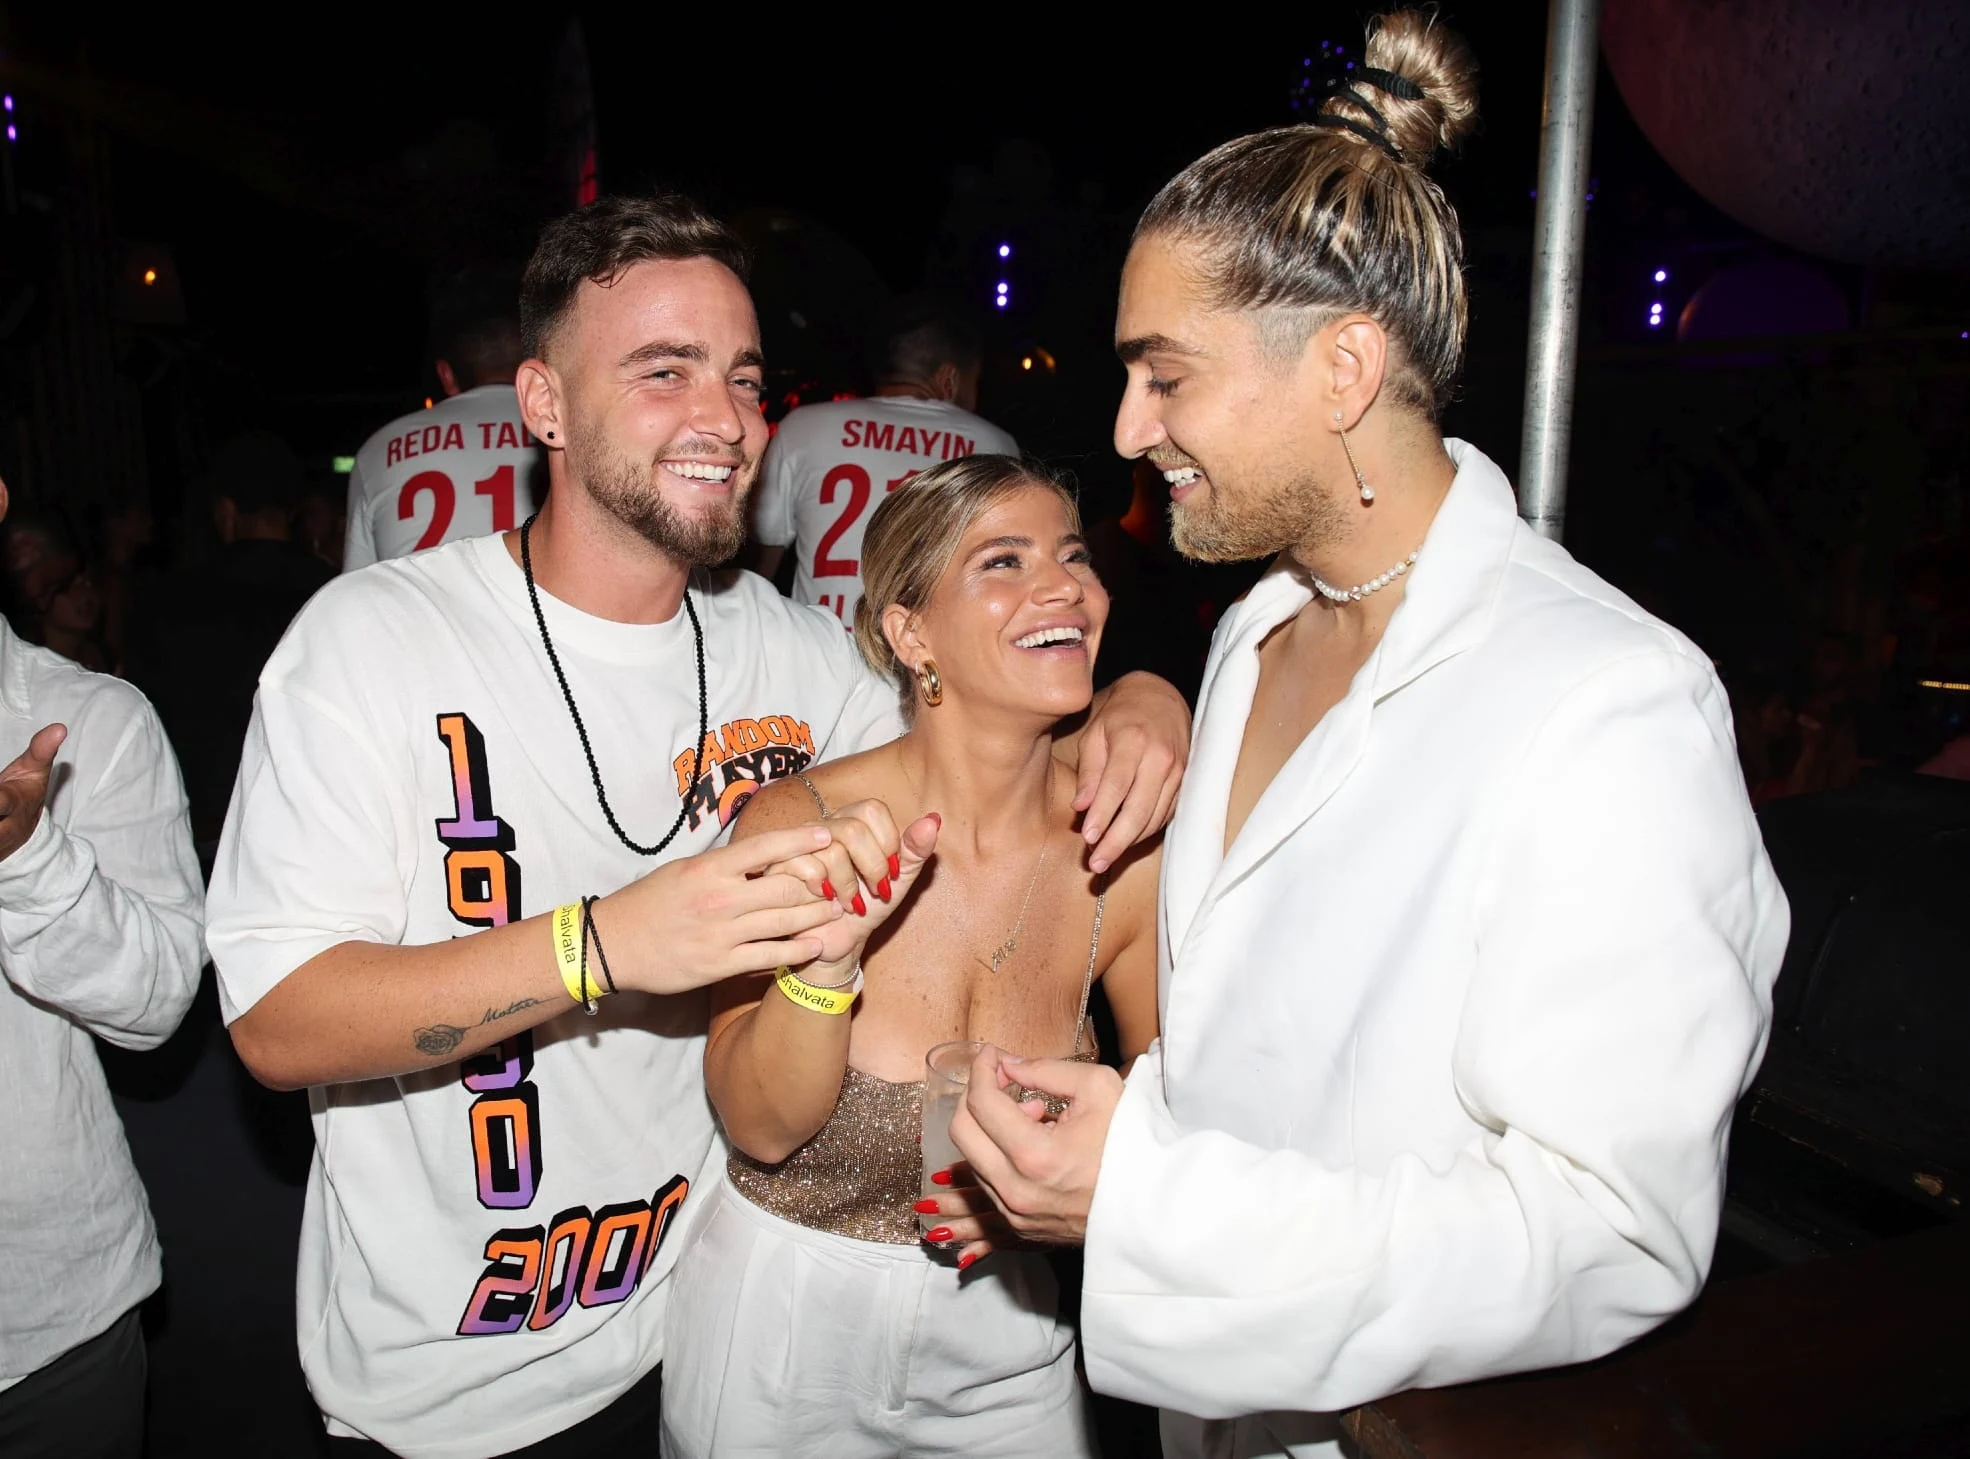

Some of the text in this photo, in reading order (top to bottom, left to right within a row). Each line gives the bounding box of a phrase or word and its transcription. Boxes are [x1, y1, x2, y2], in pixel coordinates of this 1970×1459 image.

[386, 423, 465, 468] REDA
[841, 419, 975, 460] SMAYIN
[397, 464, 515, 552] 21
[673, 715, 816, 797] RANDOM
[780, 970, 836, 1009] Shalvata
